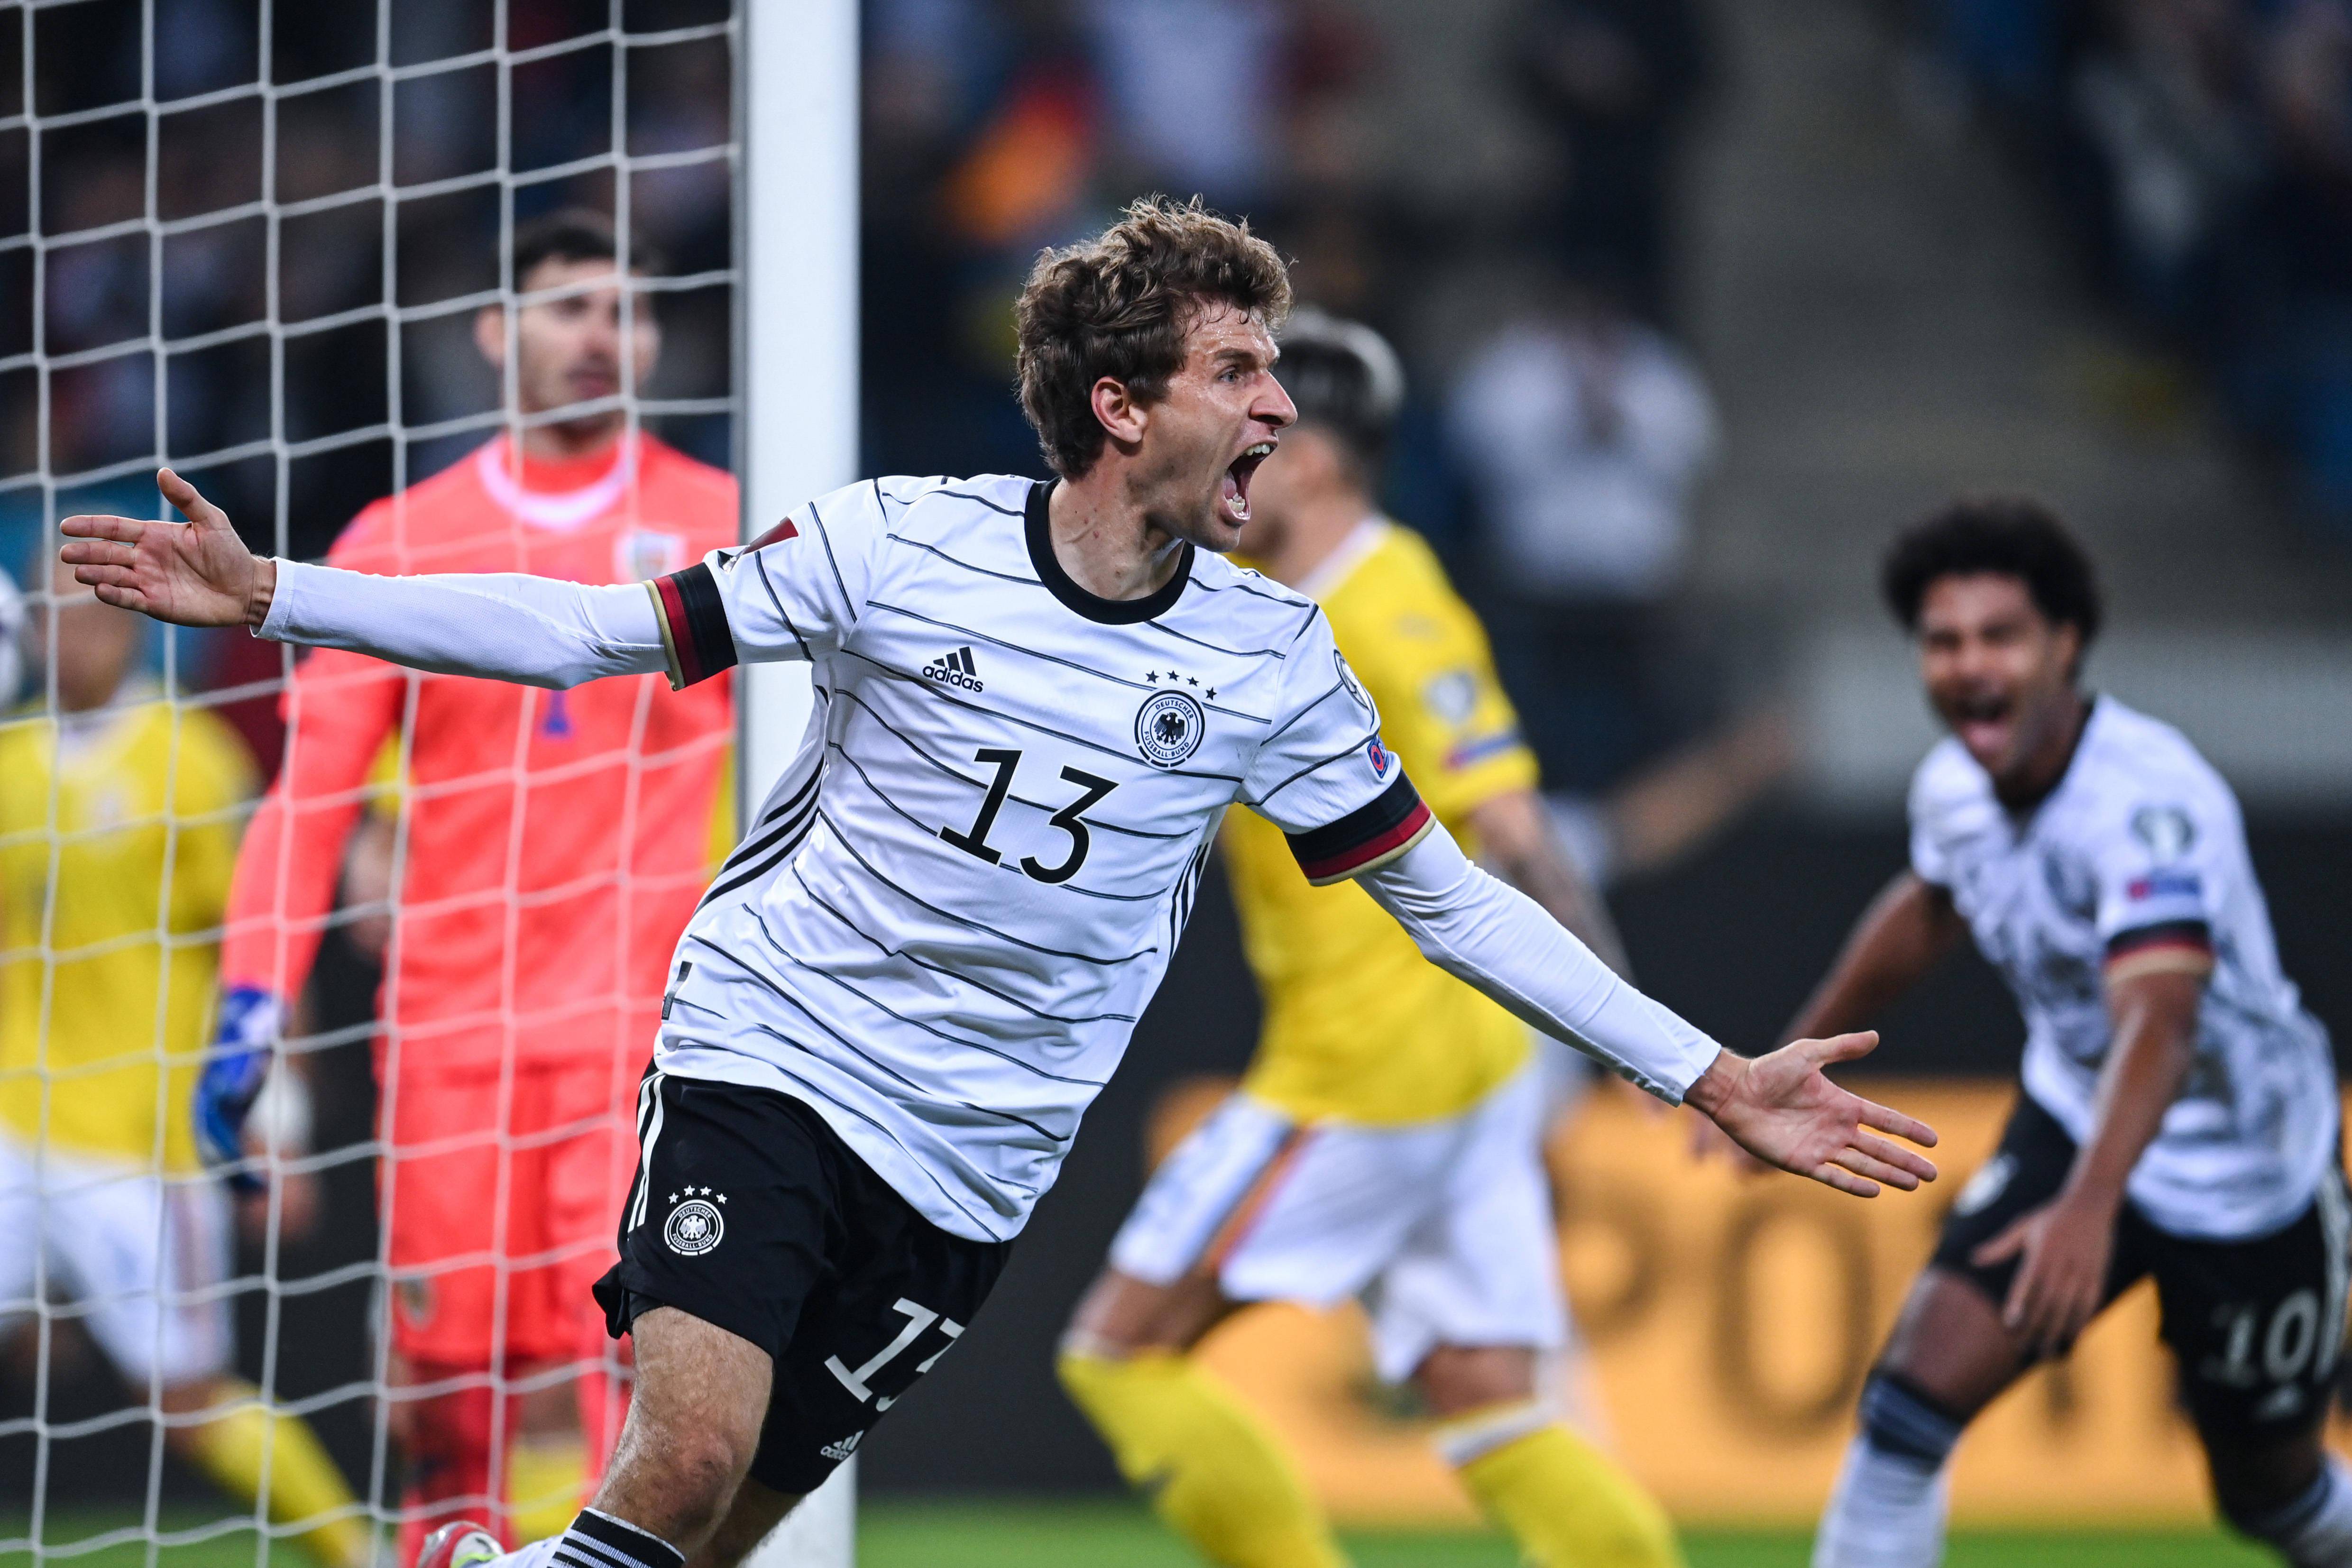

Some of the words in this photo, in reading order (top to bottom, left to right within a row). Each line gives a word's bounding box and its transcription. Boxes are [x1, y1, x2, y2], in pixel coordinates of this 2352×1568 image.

[922, 666, 983, 693] adidas
[1155, 700, 1194, 719] DEUTSCHER
[938, 748, 1120, 885] 13
[678, 1207, 712, 1219] DEUTSCHER
[2203, 1288, 2319, 1387] 10
